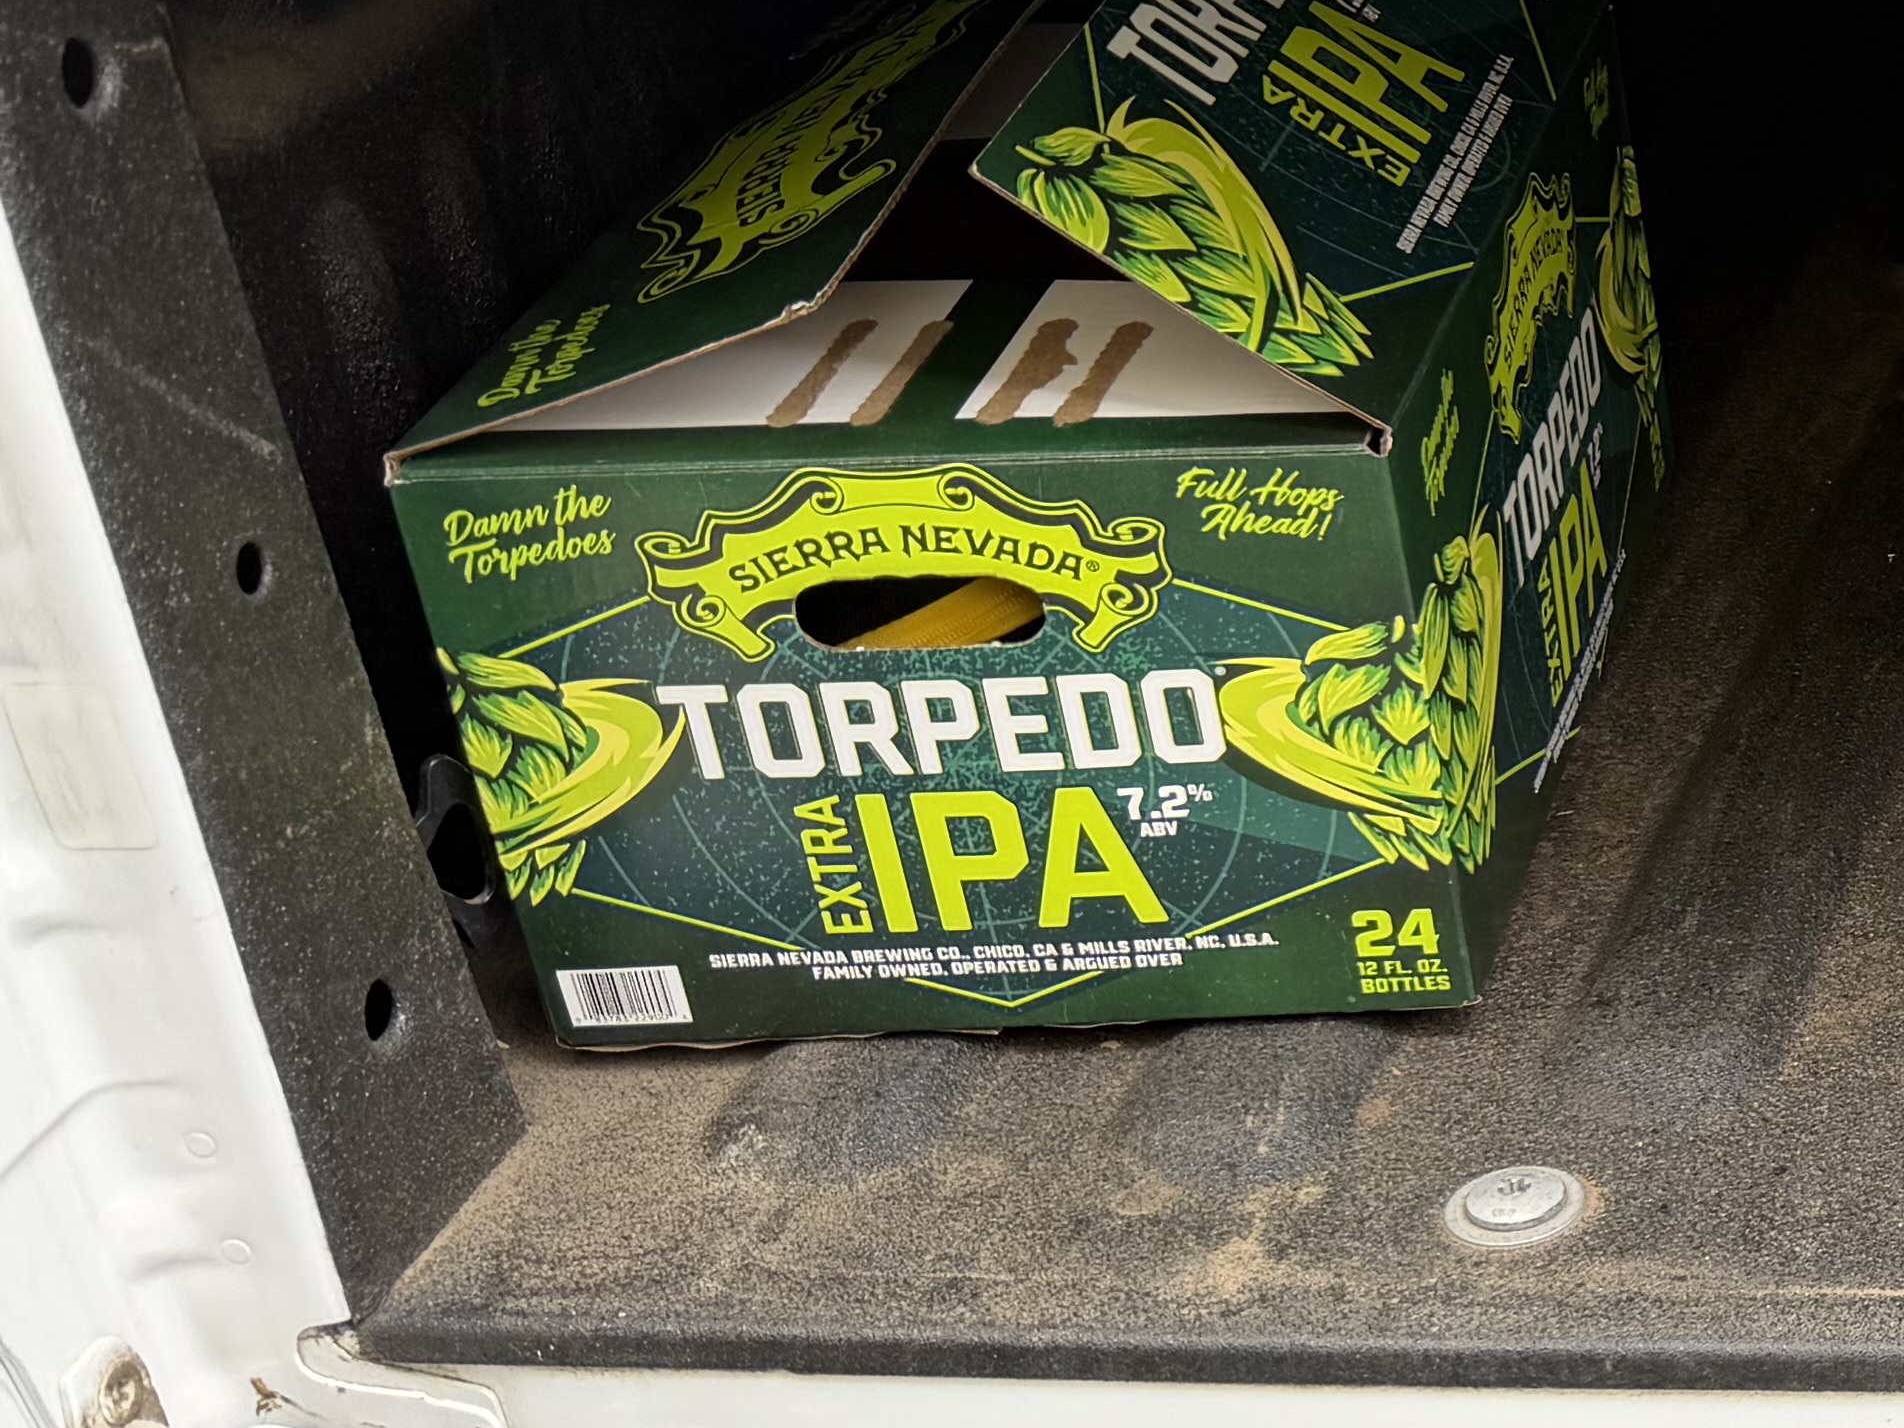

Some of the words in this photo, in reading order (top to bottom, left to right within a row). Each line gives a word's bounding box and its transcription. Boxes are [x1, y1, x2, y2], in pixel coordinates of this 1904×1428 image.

[1268, 1, 1465, 164] IPA
[1262, 74, 1411, 187] EXTRA
[1502, 306, 1601, 588] TORPEDO
[443, 509, 549, 547] Damn
[553, 484, 611, 526] the
[1176, 466, 1247, 502] Full
[1250, 467, 1345, 516] Hops
[1201, 500, 1333, 542] Ahead!
[448, 525, 616, 584] Torpedoes
[728, 527, 890, 594] SIERRA
[1549, 457, 1608, 683] IPA
[1538, 554, 1564, 709] EXTRA
[656, 668, 1226, 780] TORPEDO
[1116, 783, 1213, 821] 7.2%
[1140, 820, 1178, 838] ABV
[794, 795, 874, 935] EXTRA
[855, 786, 1169, 935] IPA
[709, 952, 774, 968] SIERRA
[777, 950, 849, 966] NEVADA
[852, 947, 933, 964] BREWING
[1033, 943, 1059, 957] CA
[1060, 942, 1074, 957] &
[1077, 939, 1130, 955] MILLS
[1229, 932, 1280, 948] U.S.A.
[1351, 907, 1440, 958] 24
[812, 965, 878, 980] FAMILY
[951, 959, 1041, 975] OPERATED
[1044, 959, 1057, 972] &
[1063, 955, 1132, 971] ARGUED
[1136, 952, 1183, 967] OVER
[1356, 960, 1379, 976] 12
[1384, 960, 1412, 975] FL.
[1360, 975, 1452, 995] BOTTLES
